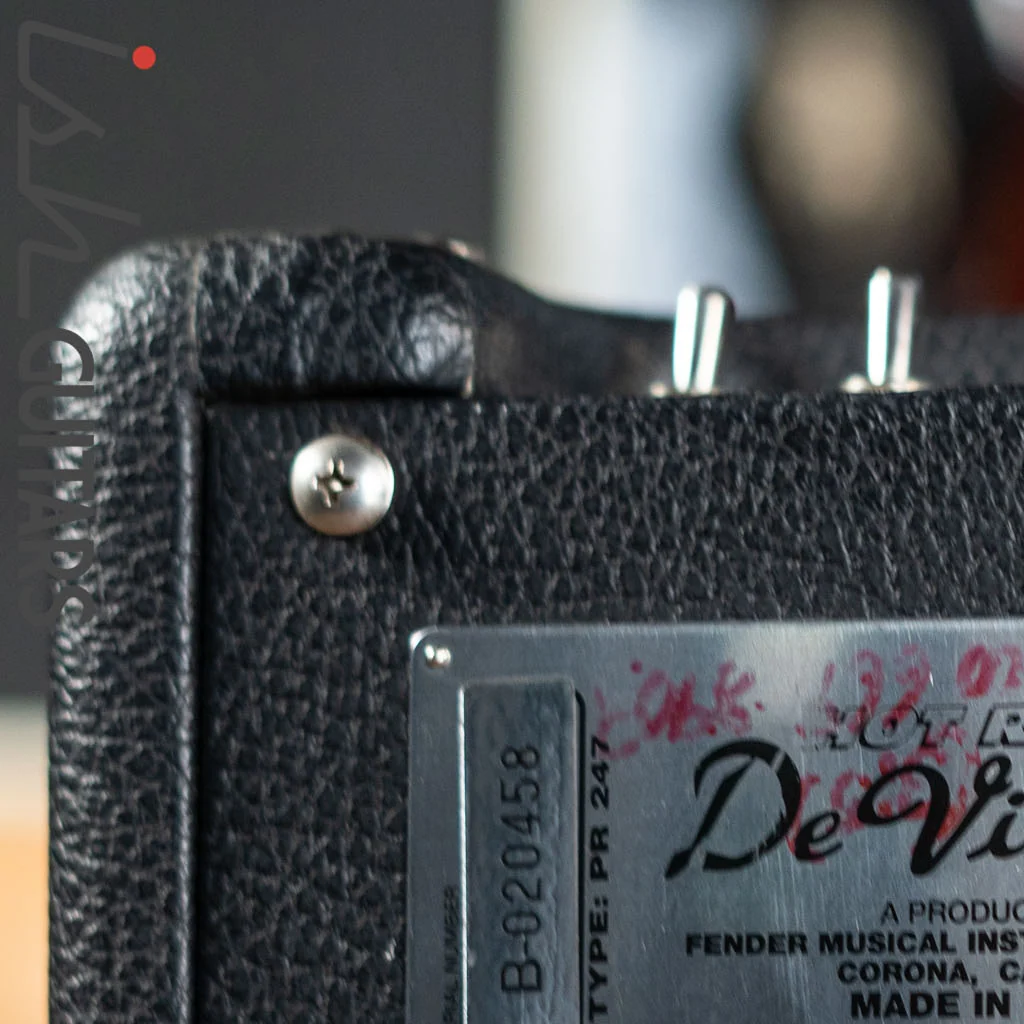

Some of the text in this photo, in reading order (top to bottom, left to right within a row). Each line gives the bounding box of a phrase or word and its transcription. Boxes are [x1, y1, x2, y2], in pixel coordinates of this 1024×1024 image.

[500, 744, 543, 994] B-020458
[588, 735, 612, 1024] TYPE: PR 247
[879, 901, 899, 924] A
[685, 932, 809, 956] FENDER
[818, 929, 957, 955] MUSICAL
[837, 960, 979, 986] CORONA,
[850, 989, 960, 1019] MADE
[973, 989, 1011, 1017] IN
